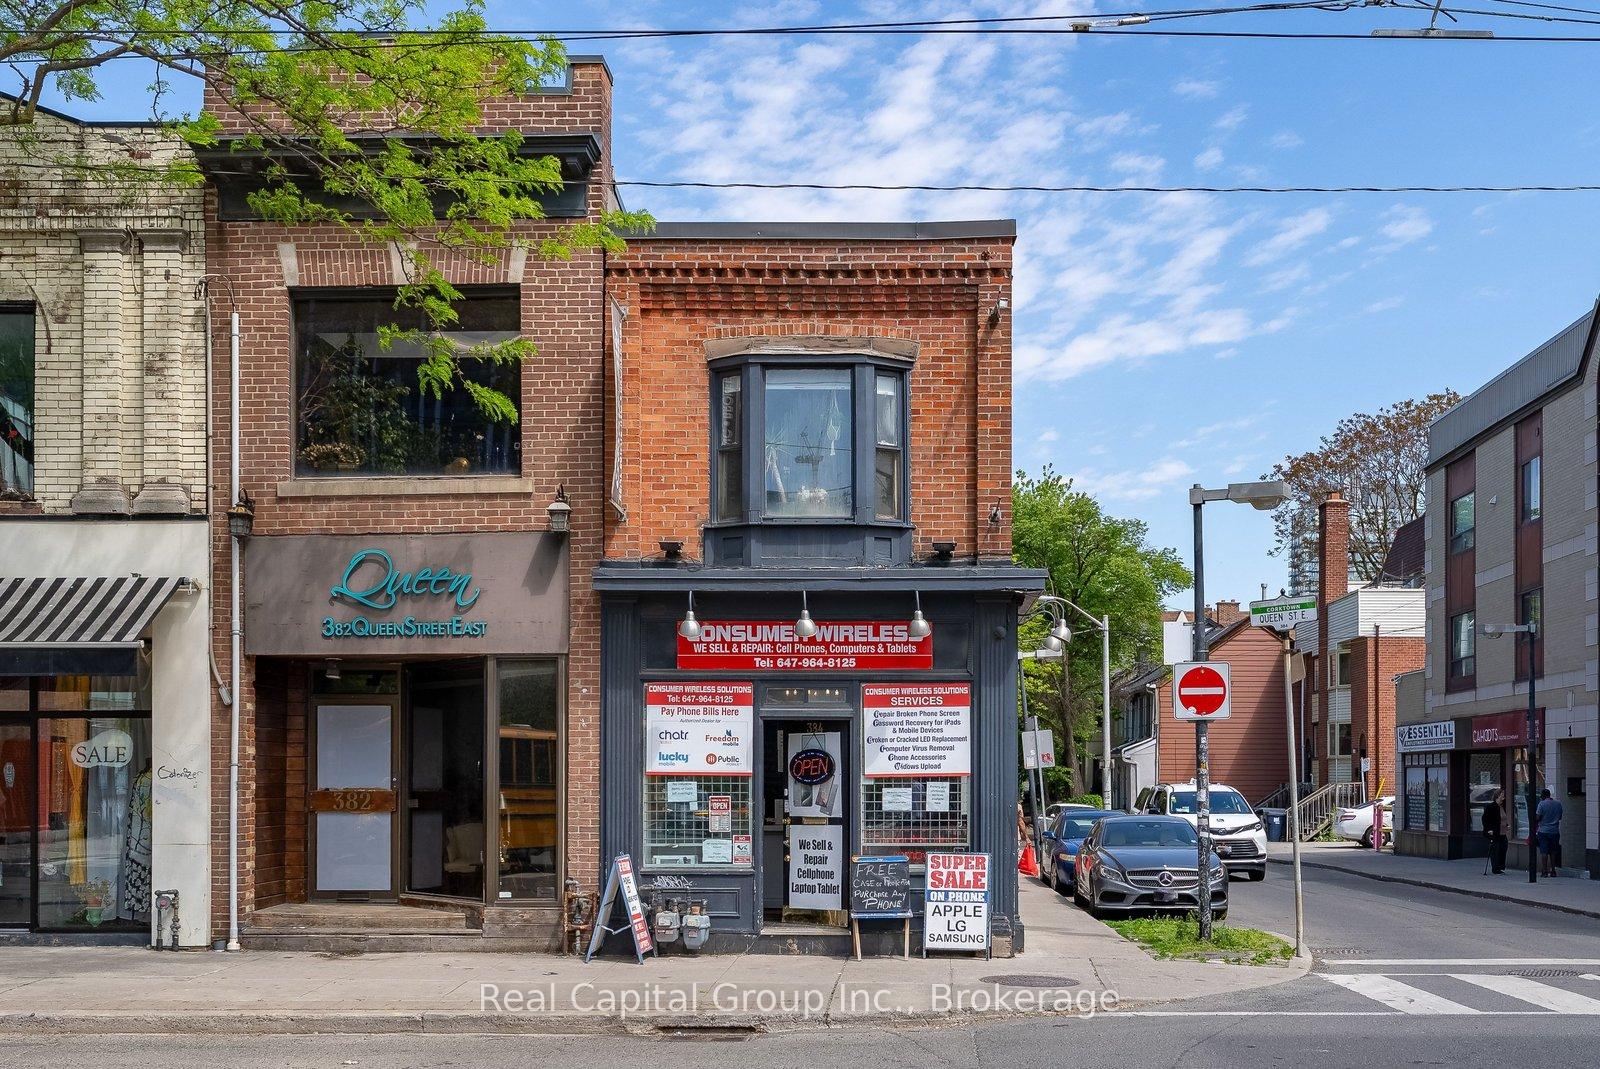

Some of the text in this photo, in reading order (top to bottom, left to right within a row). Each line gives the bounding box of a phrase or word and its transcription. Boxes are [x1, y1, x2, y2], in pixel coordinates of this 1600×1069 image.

[330, 548, 480, 610] Queen
[1266, 604, 1301, 613] CORKTOWN
[1260, 613, 1284, 623] QUEEN
[1288, 611, 1298, 620] ST
[687, 625, 924, 642] ONSUME WIRELES
[693, 643, 917, 655] WE SELL & REPAIR: Cell Phones, Computers & Tablets
[754, 657, 857, 668] Tel: 647-964-8125
[648, 685, 684, 693] CONSUMER
[684, 685, 716, 693] WIRELESS
[901, 687, 932, 695] WIRELESS
[667, 694, 734, 703] Tel: 647-964-8125
[890, 696, 944, 706] SERVICES
[661, 706, 740, 717] Pay Phone Bills Here
[658, 730, 689, 740] chatr
[1407, 722, 1454, 739] ESSENTIAL
[1472, 728, 1499, 742] CAHOOTS
[1568, 725, 1573, 737] 1
[705, 734, 739, 742] Freedom
[931, 735, 968, 743] Replacement
[75, 745, 128, 764] SALE
[658, 751, 689, 763] lucky
[717, 755, 740, 763] Public
[792, 756, 829, 776] OPEN
[920, 762, 942, 770] Upload
[332, 792, 372, 810] 382
[712, 802, 728, 810] OPEN
[798, 839, 834, 851] We Sell &
[803, 854, 829, 866] Repair
[930, 855, 986, 870] SUPER
[797, 868, 835, 880] Cellphone
[856, 863, 898, 877] FREE
[930, 871, 986, 889] SALE
[791, 882, 840, 895] Laptop Tablet
[930, 891, 985, 902] ON PHONE
[861, 897, 903, 910] PHONE
[931, 905, 983, 917] APPLE
[947, 920, 967, 932] LG
[928, 933, 985, 943] SAMSUNG
